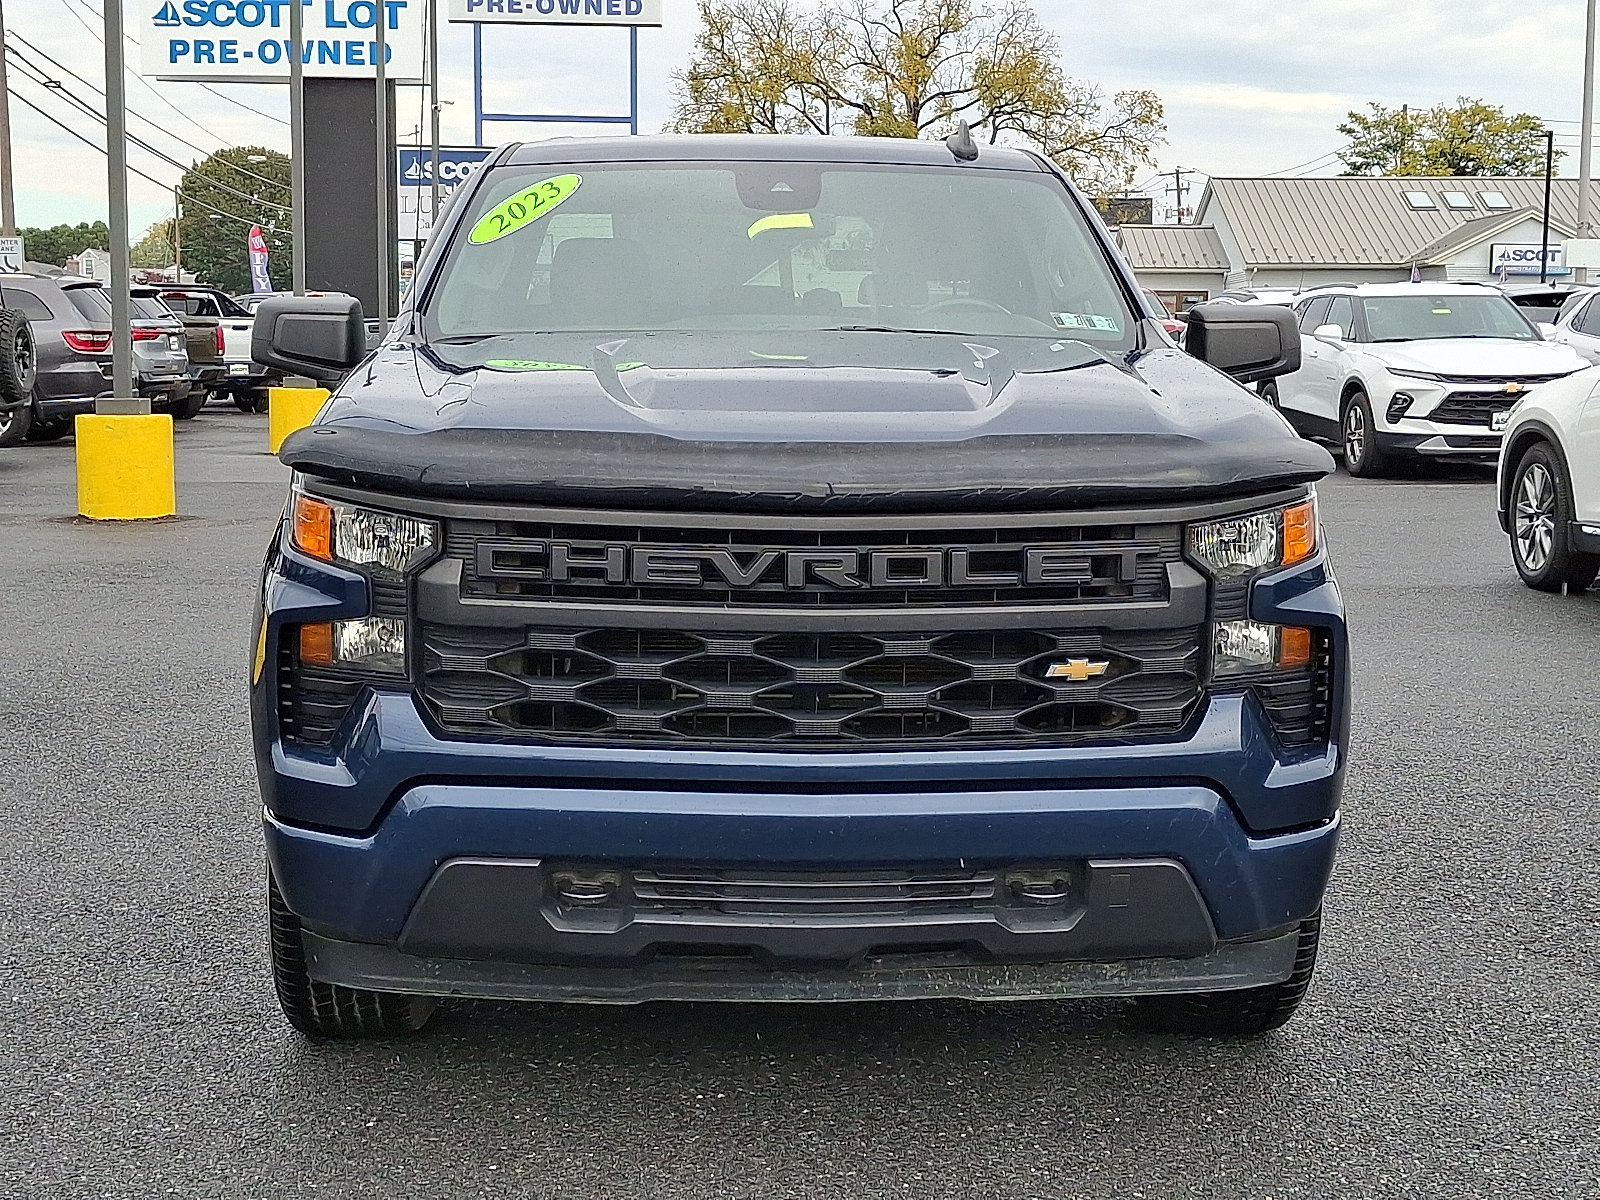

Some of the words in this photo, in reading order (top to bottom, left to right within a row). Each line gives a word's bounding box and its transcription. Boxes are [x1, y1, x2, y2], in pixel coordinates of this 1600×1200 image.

[325, 1, 407, 29] LOT
[466, 0, 643, 15] PRE-OWNED
[169, 39, 392, 65] PRE-OWNED
[489, 181, 561, 233] 2023
[475, 540, 1162, 588] CHEVROLET
